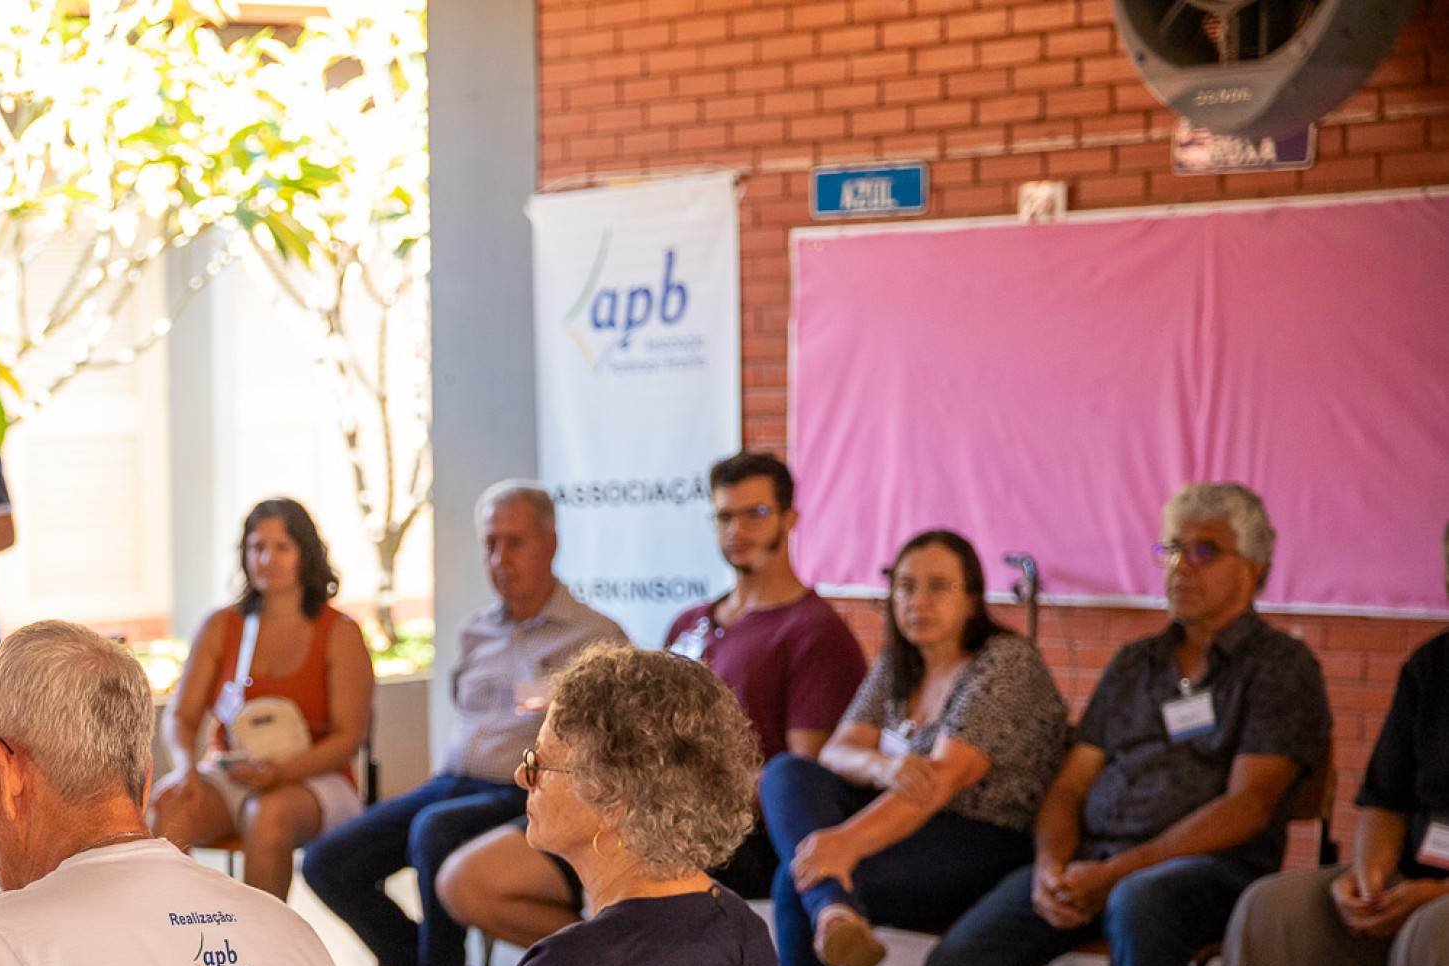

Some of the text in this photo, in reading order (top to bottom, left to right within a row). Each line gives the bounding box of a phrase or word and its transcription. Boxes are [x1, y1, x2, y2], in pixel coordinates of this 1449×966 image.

[591, 248, 688, 348] apb
[553, 474, 711, 506] ASSOCIAÇÃ
[574, 577, 707, 601] ARKINSON
[168, 911, 237, 926] Realização:
